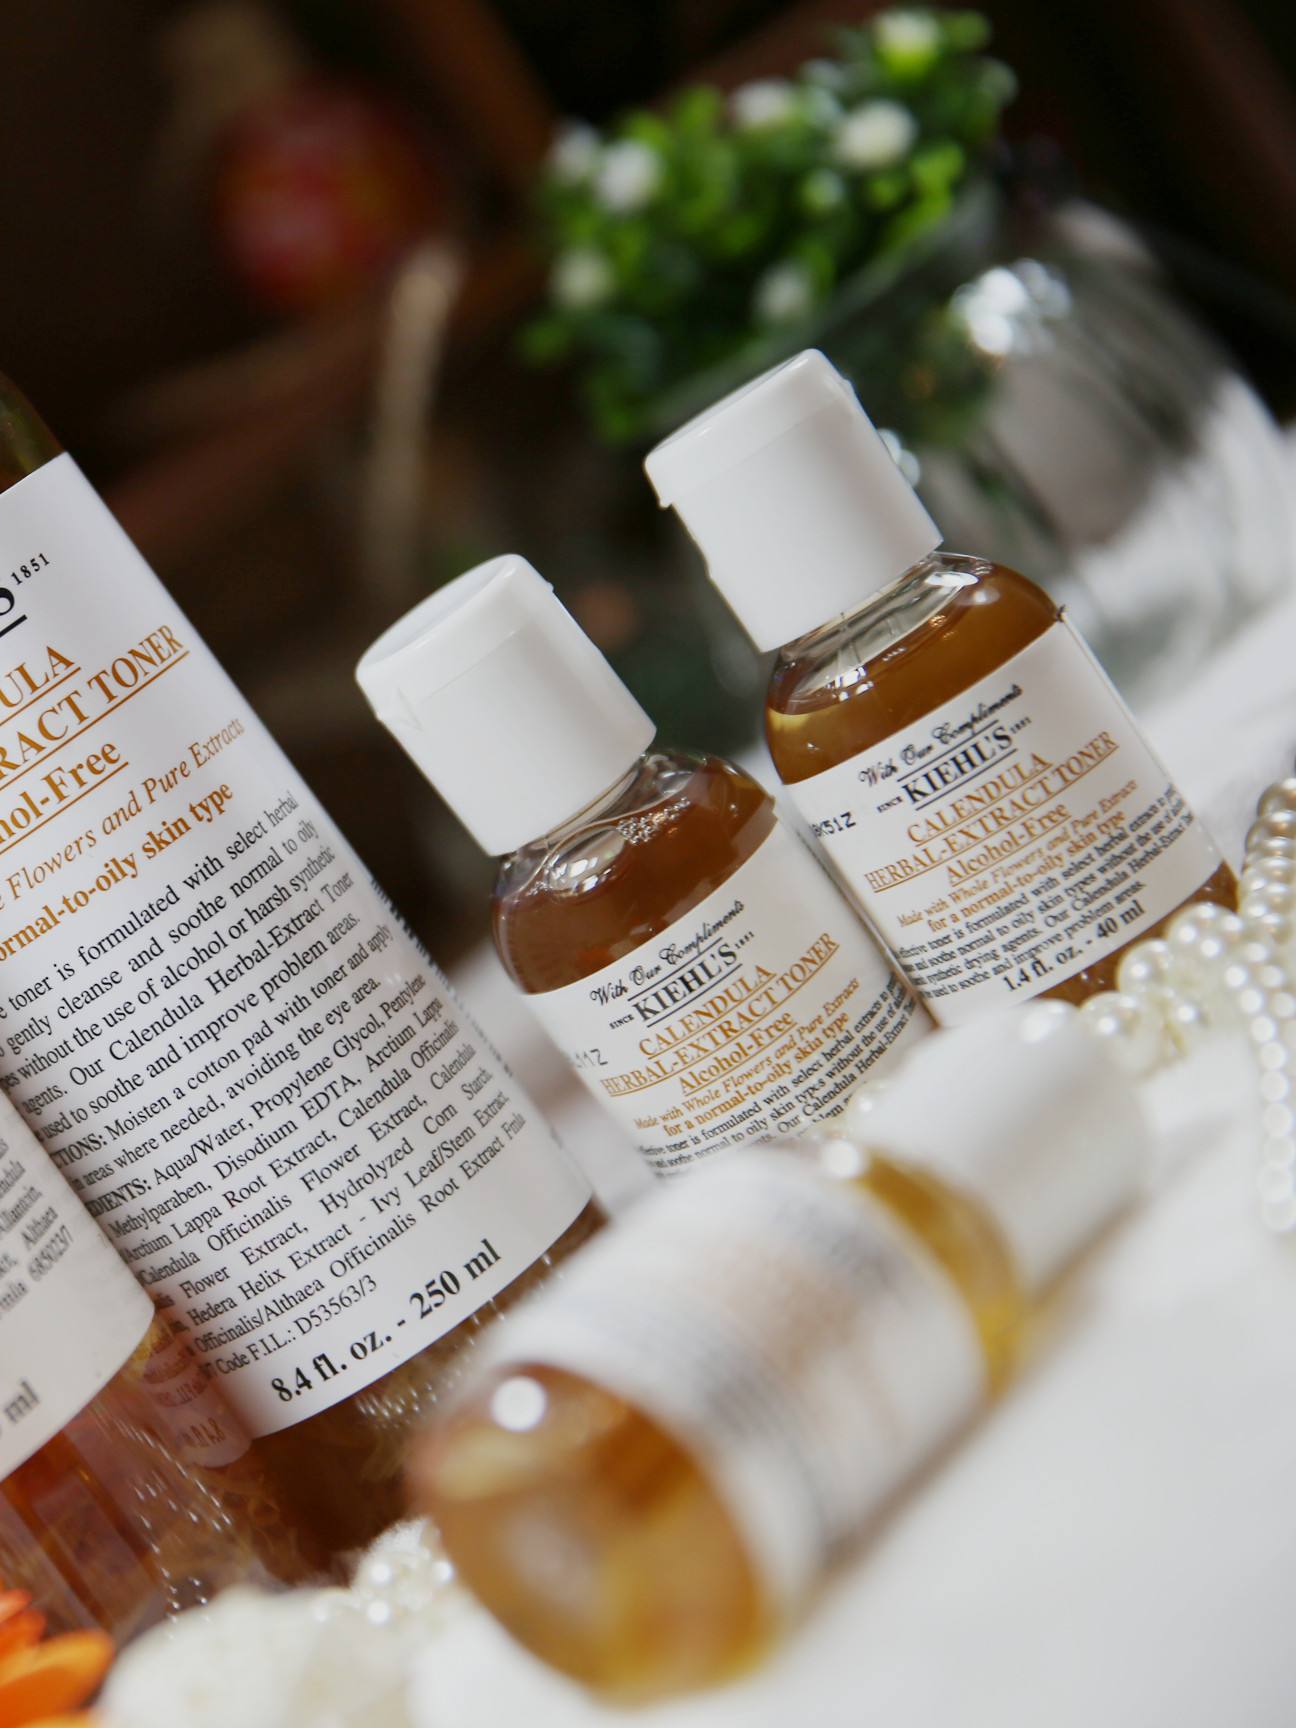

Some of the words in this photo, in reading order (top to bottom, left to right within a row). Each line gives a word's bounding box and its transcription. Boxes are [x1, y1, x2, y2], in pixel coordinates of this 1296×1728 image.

[11, 553, 50, 585] 1851
[86, 625, 182, 704] TONER
[5, 829, 97, 900] Flowers
[102, 789, 143, 836] and
[141, 760, 191, 805] Pure
[187, 720, 241, 769] Extracts
[859, 758, 899, 786] With
[864, 776, 1058, 890] HERBAL-EXTRACT
[1051, 731, 1116, 790] TONER
[901, 726, 1012, 804] KIEHL'S
[907, 753, 1053, 847] CALENDULA
[142, 817, 192, 860] skin
[189, 784, 233, 823] type
[927, 917, 949, 933] for
[950, 913, 961, 924] a
[959, 854, 1065, 918] normal-to-oily
[1066, 831, 1099, 857] skin
[1096, 811, 1126, 837] type
[946, 804, 1070, 887] Alcohol-Free
[6, 1015, 53, 1056] gently
[57, 970, 123, 1020] cleanse
[127, 936, 165, 973] and
[168, 895, 227, 944] soothe
[229, 846, 284, 899] normal
[8, 976, 53, 1011] toner
[77, 884, 181, 966] formulated
[182, 855, 225, 890] with
[226, 821, 268, 860] select
[590, 979, 629, 1006] With
[629, 964, 662, 987] Our
[658, 900, 745, 966] Compliments
[965, 892, 1031, 934] formulated
[1030, 876, 1061, 897] with
[1003, 968, 1032, 991] 1.4
[1030, 957, 1054, 978] fl.
[1055, 946, 1084, 965] oz.
[1096, 917, 1118, 939] 40
[1119, 899, 1146, 924] ml
[17, 1039, 75, 1079] without
[72, 1023, 103, 1047] the
[101, 1001, 136, 1028] use
[160, 930, 229, 990] alcohol
[243, 884, 293, 926] harsh
[69, 1058, 105, 1086] Our
[109, 994, 205, 1061] Calendula
[204, 899, 325, 995] Herbal-Extract
[319, 872, 354, 904] Toner
[88, 1073, 145, 1114] soothe
[146, 1043, 183, 1079] and
[179, 993, 260, 1053] improve
[259, 940, 329, 1003] problem
[605, 987, 780, 1094] HERBAL-EXTRACT
[775, 932, 840, 993] TONER
[609, 1014, 635, 1030] SINCE
[631, 943, 737, 1022] KIEHL'S
[639, 965, 777, 1060] CALENDULA
[103, 1096, 172, 1141] Moisten
[187, 1049, 241, 1090] cotton
[241, 1019, 275, 1057] pad
[273, 994, 312, 1026] with
[310, 964, 348, 999] toner
[113, 1137, 160, 1169] where
[160, 1094, 226, 1143] needed,
[225, 1042, 300, 1100] avoiding
[297, 1022, 324, 1046] the
[325, 1000, 351, 1026] eye
[153, 1118, 254, 1185] Aqua/Water,
[250, 1056, 333, 1120] Propylene
[332, 1013, 386, 1058] Glycol,
[659, 1106, 684, 1122] with
[681, 1089, 722, 1112] Whole
[722, 1055, 773, 1093] Flowers
[774, 1034, 798, 1060] and
[796, 1014, 825, 1041] Pure
[662, 1123, 683, 1137] for
[684, 1119, 695, 1130] a
[694, 1060, 793, 1125] normal-to-oily
[794, 1036, 825, 1063] skin
[821, 1012, 849, 1039] type
[679, 1012, 794, 1094] Alcohol-Free
[700, 1101, 763, 1141] formulated
[762, 1085, 791, 1106] with
[791, 1060, 824, 1088] select
[821, 1029, 856, 1063] herbal
[777, 1114, 801, 1134] Our
[802, 1072, 858, 1117] Calendula
[107, 1181, 213, 1238] Methylparaben,
[212, 1120, 299, 1180] Disodium
[299, 1074, 362, 1121] EDTA,
[170, 1206, 223, 1239] Lappa
[221, 1175, 268, 1209] Root
[267, 1129, 337, 1179] Extract,
[338, 1068, 412, 1128] Calendula
[207, 1194, 293, 1252] Officinalis
[299, 1143, 361, 1193] Flower
[367, 1094, 428, 1142] Extract,
[318, 1136, 414, 1215] Hydrolyzed
[422, 1104, 458, 1135] Corn
[745, 1117, 769, 1136] oily
[769, 1101, 796, 1122] skin
[237, 1268, 287, 1301] Helix
[370, 1187, 401, 1213] Ivy
[403, 1126, 477, 1188] Leaf/Stem
[204, 1279, 326, 1346] Officinalis/Althaea
[329, 1213, 417, 1278] Officinalis
[215, 1352, 251, 1375] Code
[245, 1329, 297, 1361] F.I.L.:
[293, 1274, 377, 1335] D53563/3
[271, 1367, 313, 1402] 8.4
[312, 1353, 348, 1382] fl.
[350, 1331, 392, 1361] oz.
[409, 1270, 461, 1319] 250
[463, 1238, 502, 1280] ml
[3, 1380, 40, 1424] ml
